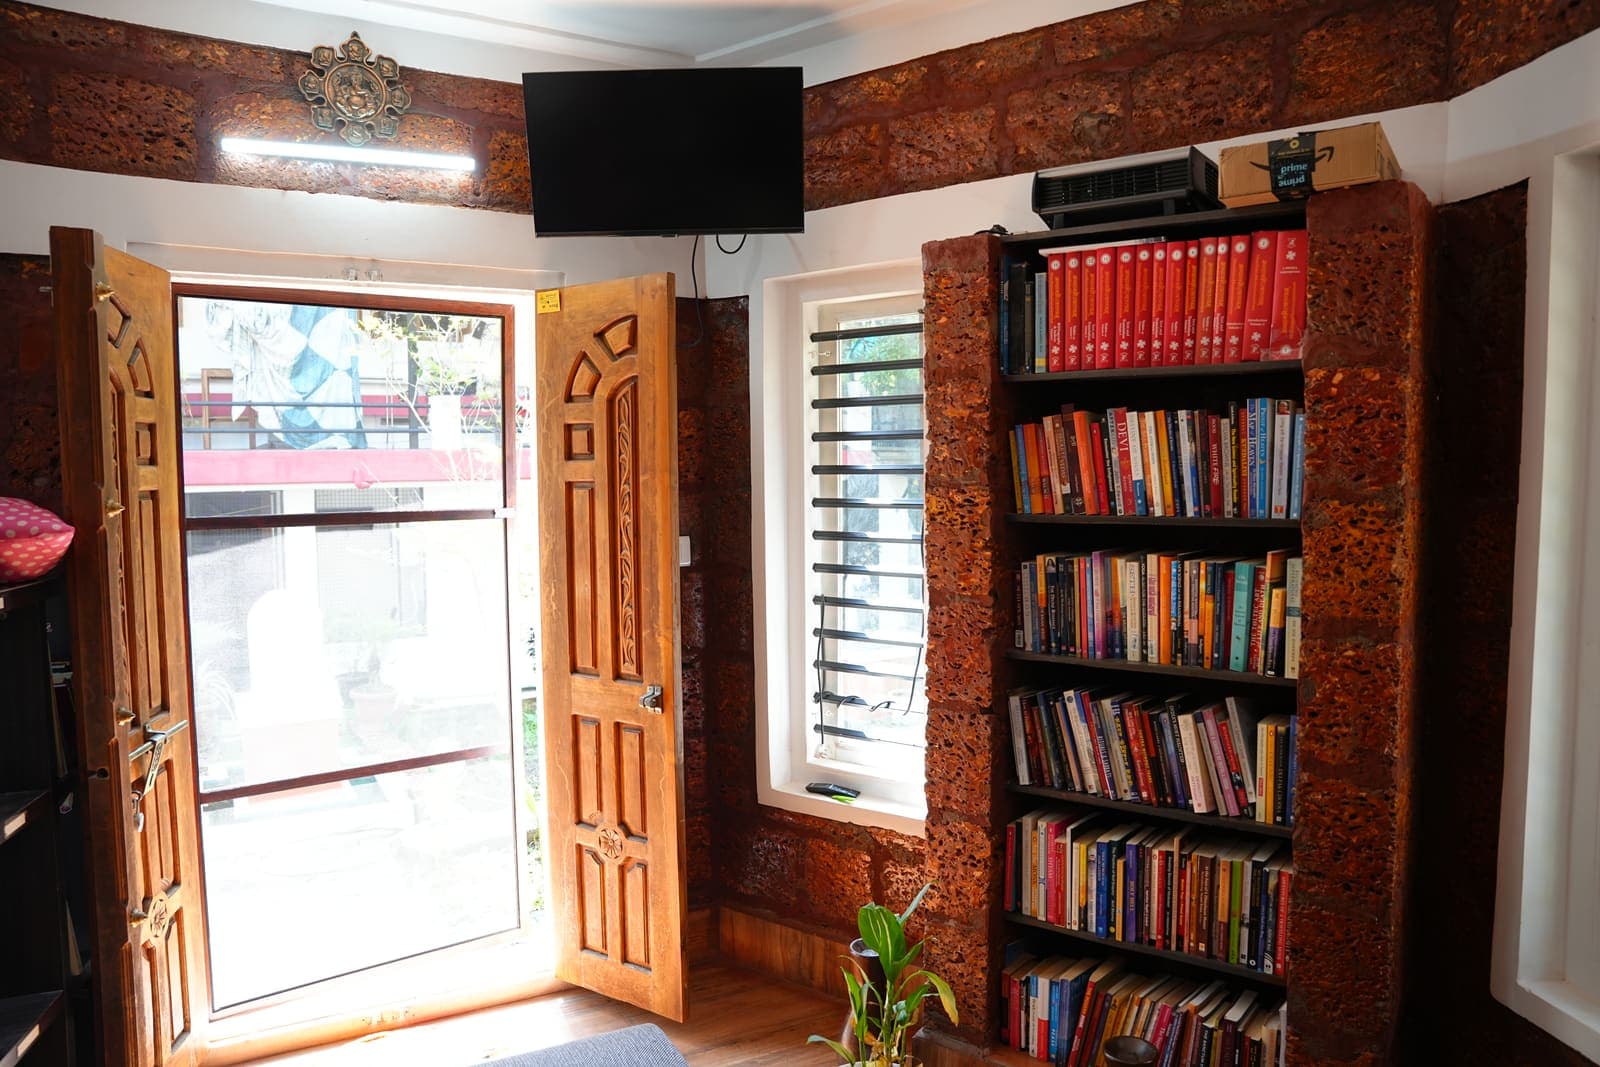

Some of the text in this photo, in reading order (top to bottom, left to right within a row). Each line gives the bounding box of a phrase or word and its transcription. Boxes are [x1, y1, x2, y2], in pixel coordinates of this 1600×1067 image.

[1280, 163, 1308, 175] prime
[1278, 175, 1305, 187] prime
[1117, 422, 1128, 452] DEVI
